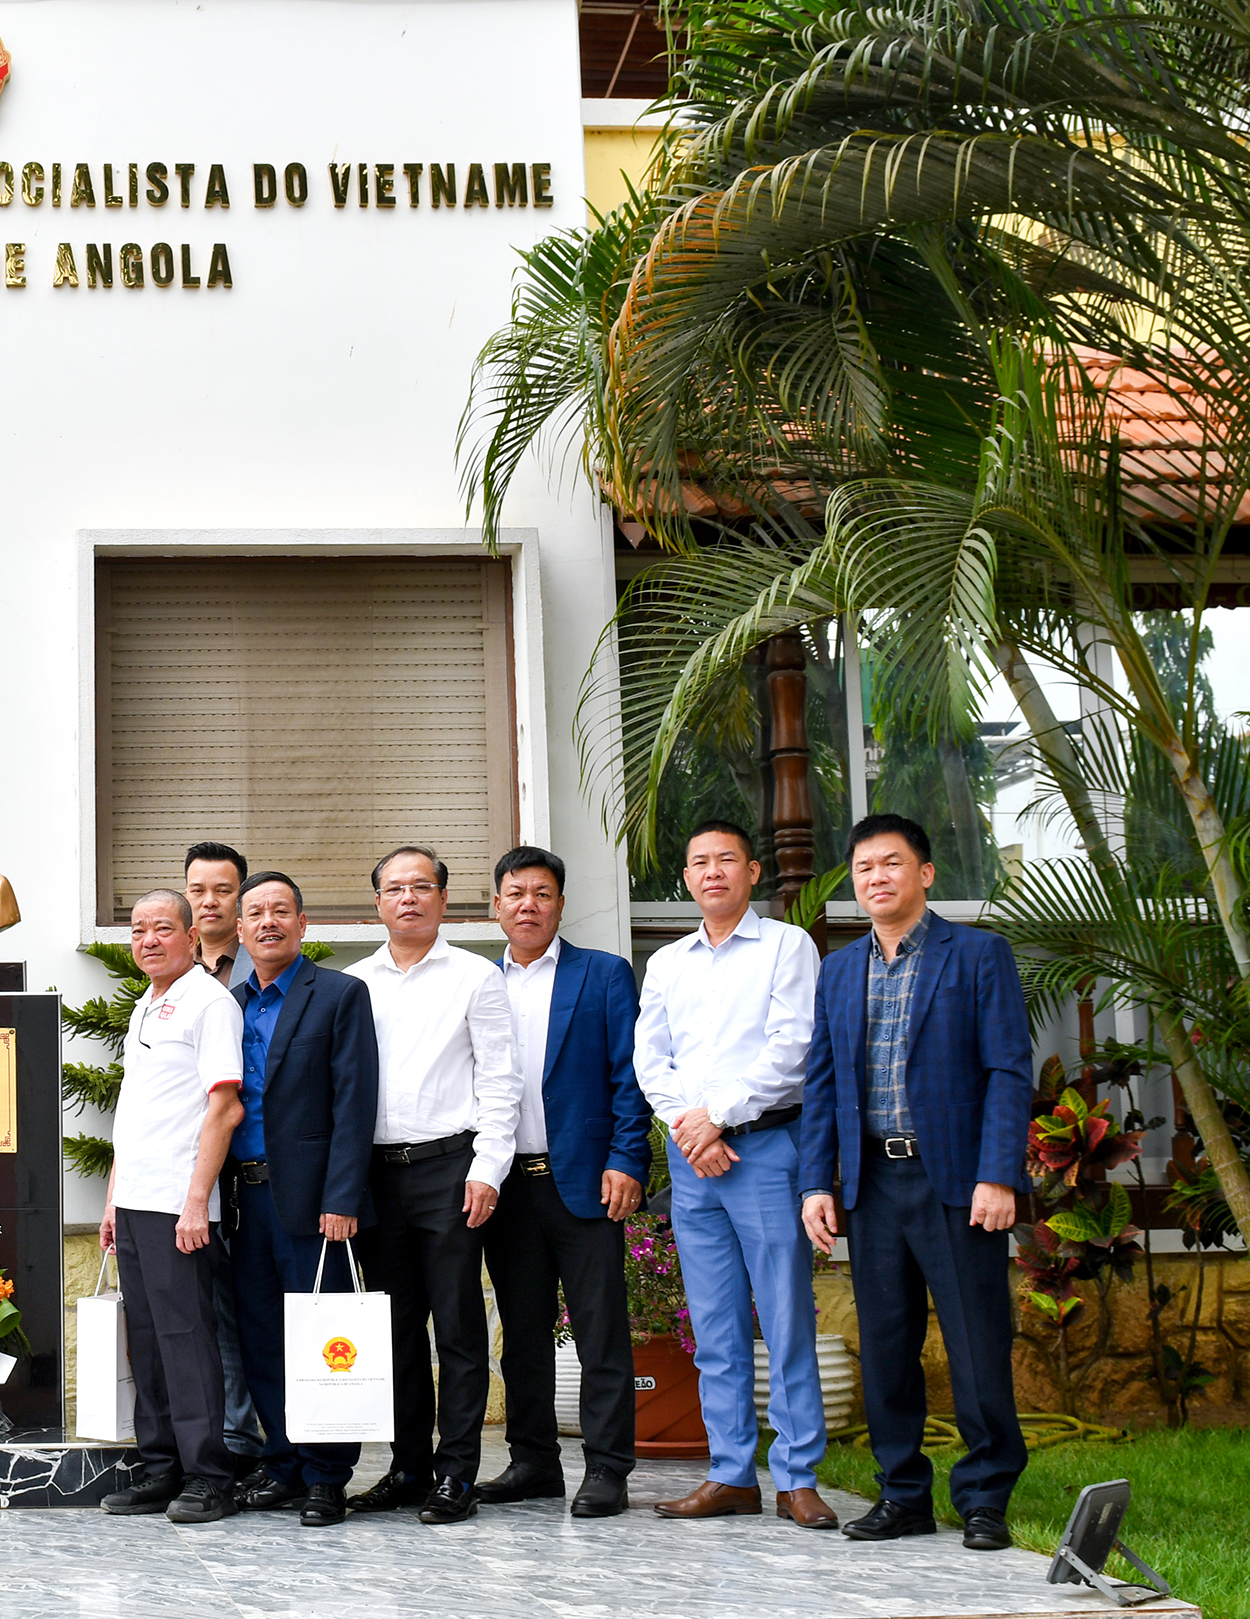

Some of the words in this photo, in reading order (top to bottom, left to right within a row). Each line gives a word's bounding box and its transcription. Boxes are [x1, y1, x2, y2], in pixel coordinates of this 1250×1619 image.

[254, 162, 309, 208] DO
[328, 162, 555, 208] VIETNAME
[54, 242, 233, 288] ANGOLA
